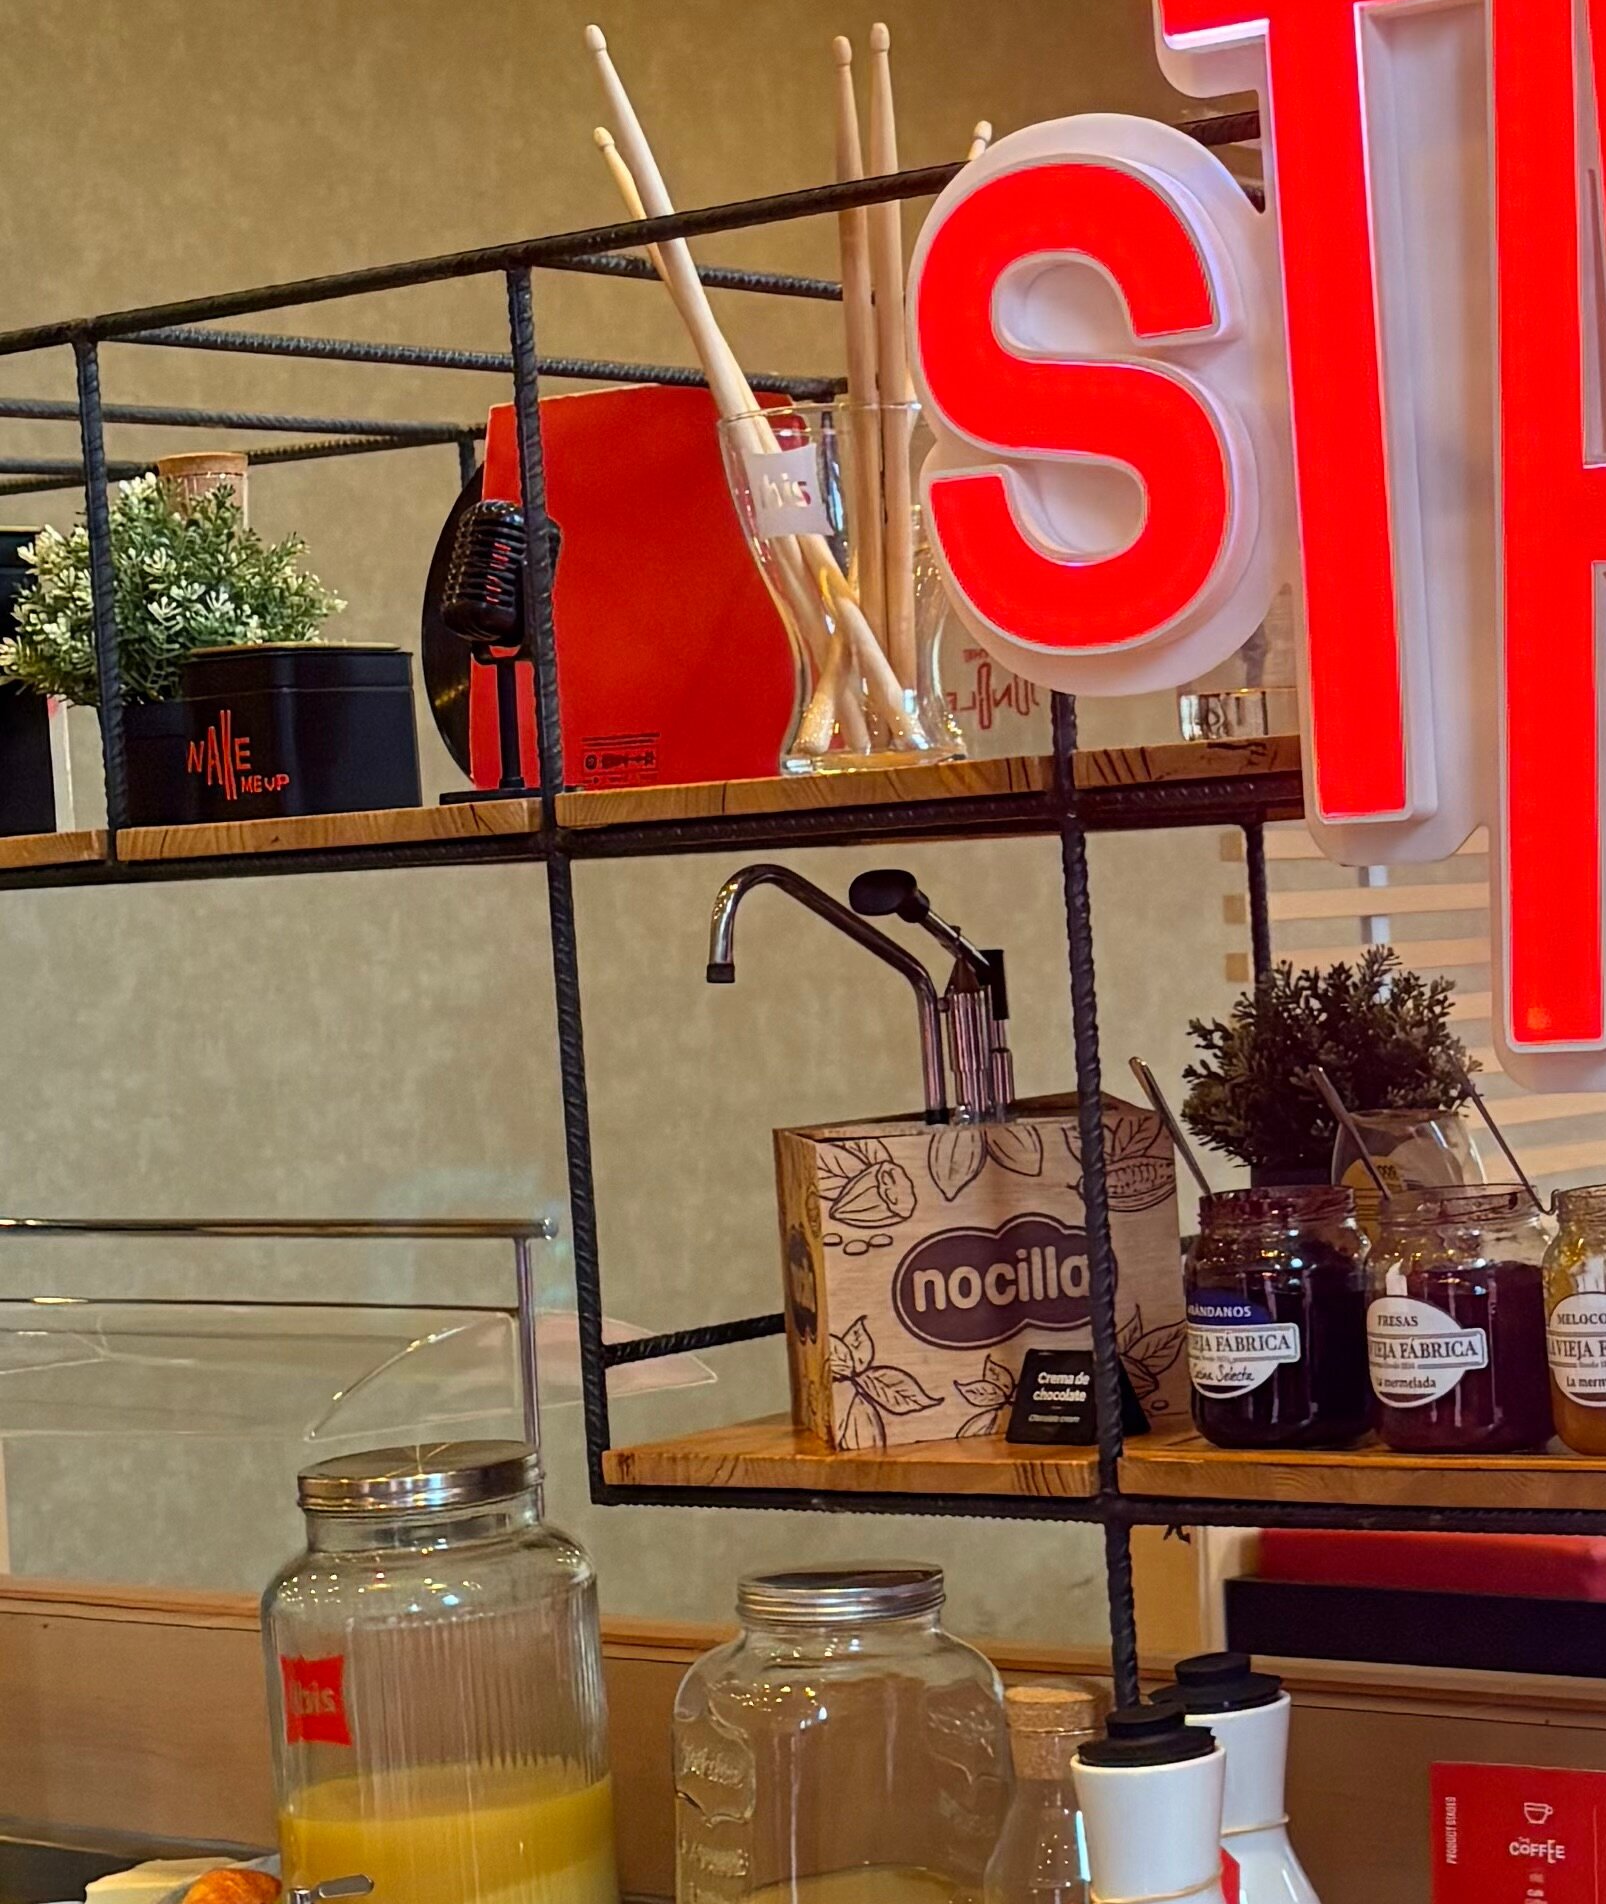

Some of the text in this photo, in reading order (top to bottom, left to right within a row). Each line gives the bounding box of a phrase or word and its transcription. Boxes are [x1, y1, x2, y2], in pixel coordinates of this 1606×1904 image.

[913, 1245, 1090, 1312] nocilla
[1377, 1314, 1419, 1327] FRESAS
[1216, 1330, 1292, 1353] FÁBRICA
[1399, 1336, 1479, 1360] FÁBRICA
[1037, 1371, 1075, 1385] Crema
[1032, 1387, 1087, 1403] chocolate
[1508, 1839, 1567, 1864] COFFEE
